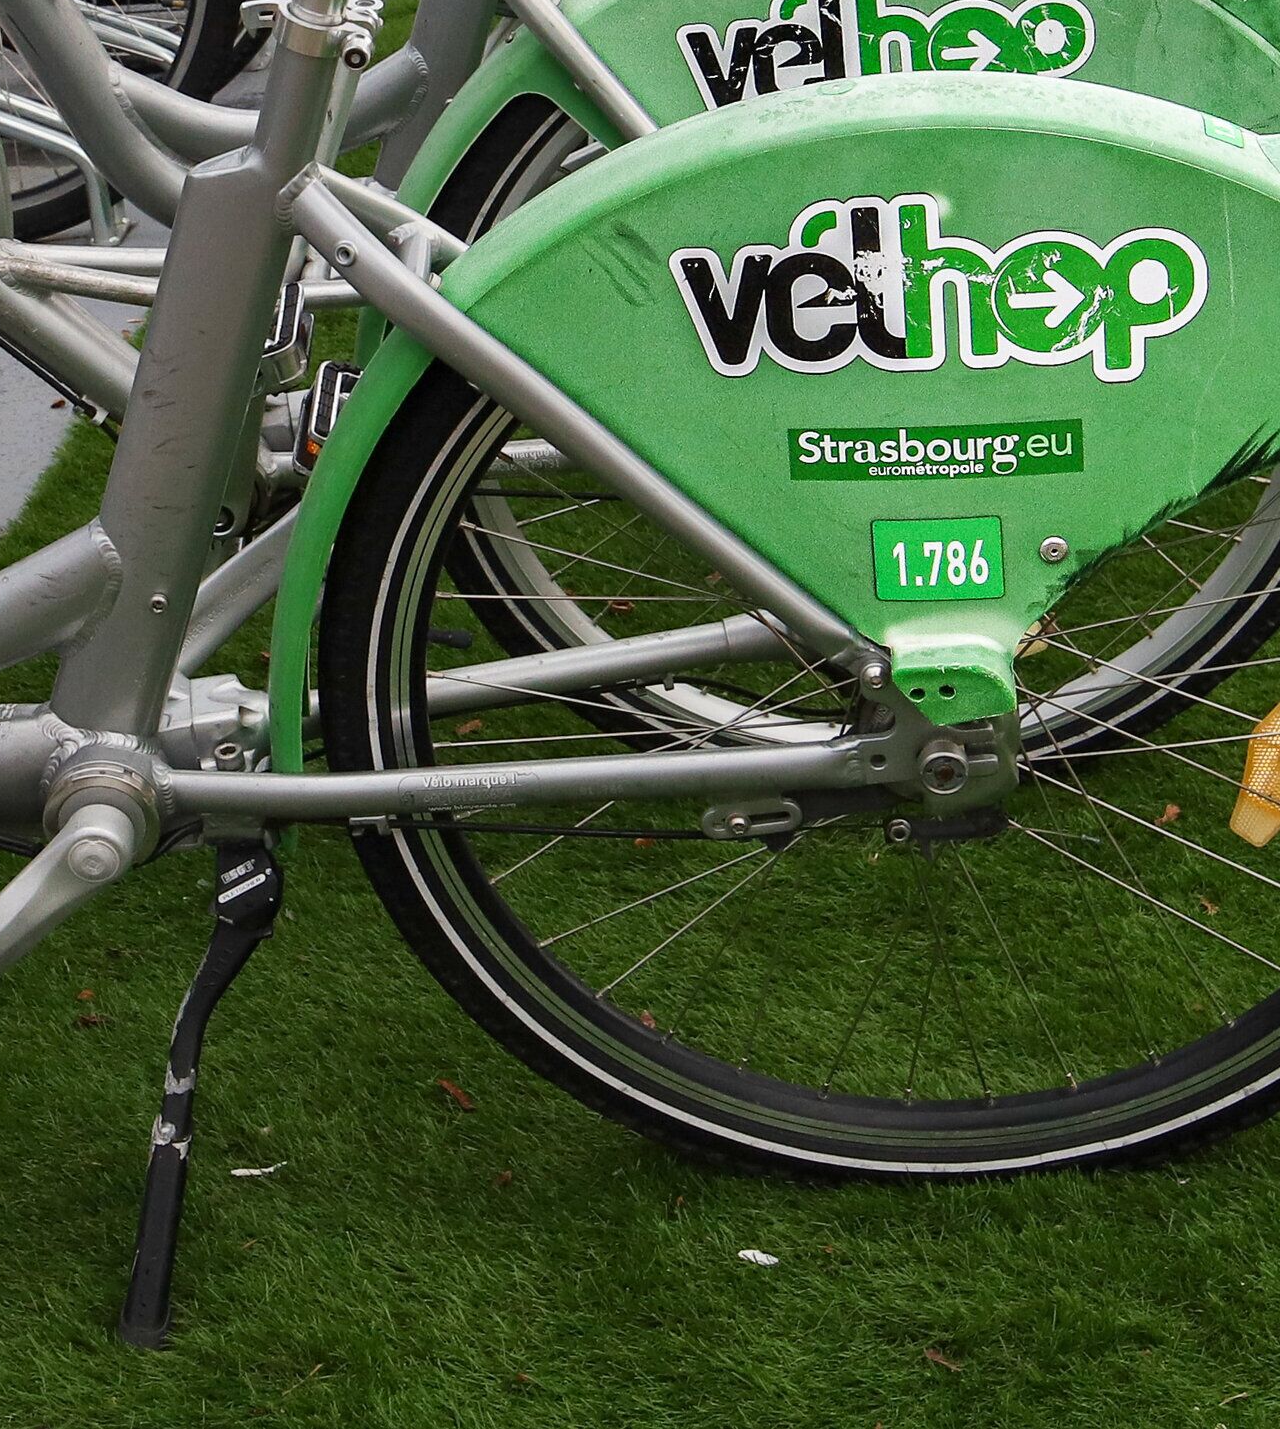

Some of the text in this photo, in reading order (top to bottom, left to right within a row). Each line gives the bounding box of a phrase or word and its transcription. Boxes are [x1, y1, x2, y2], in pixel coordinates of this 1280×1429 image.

[797, 428, 1074, 474] Strasbourg.eu
[868, 460, 984, 478] eurométropole
[891, 539, 990, 588] 1.786
[423, 775, 453, 788] Vélo
